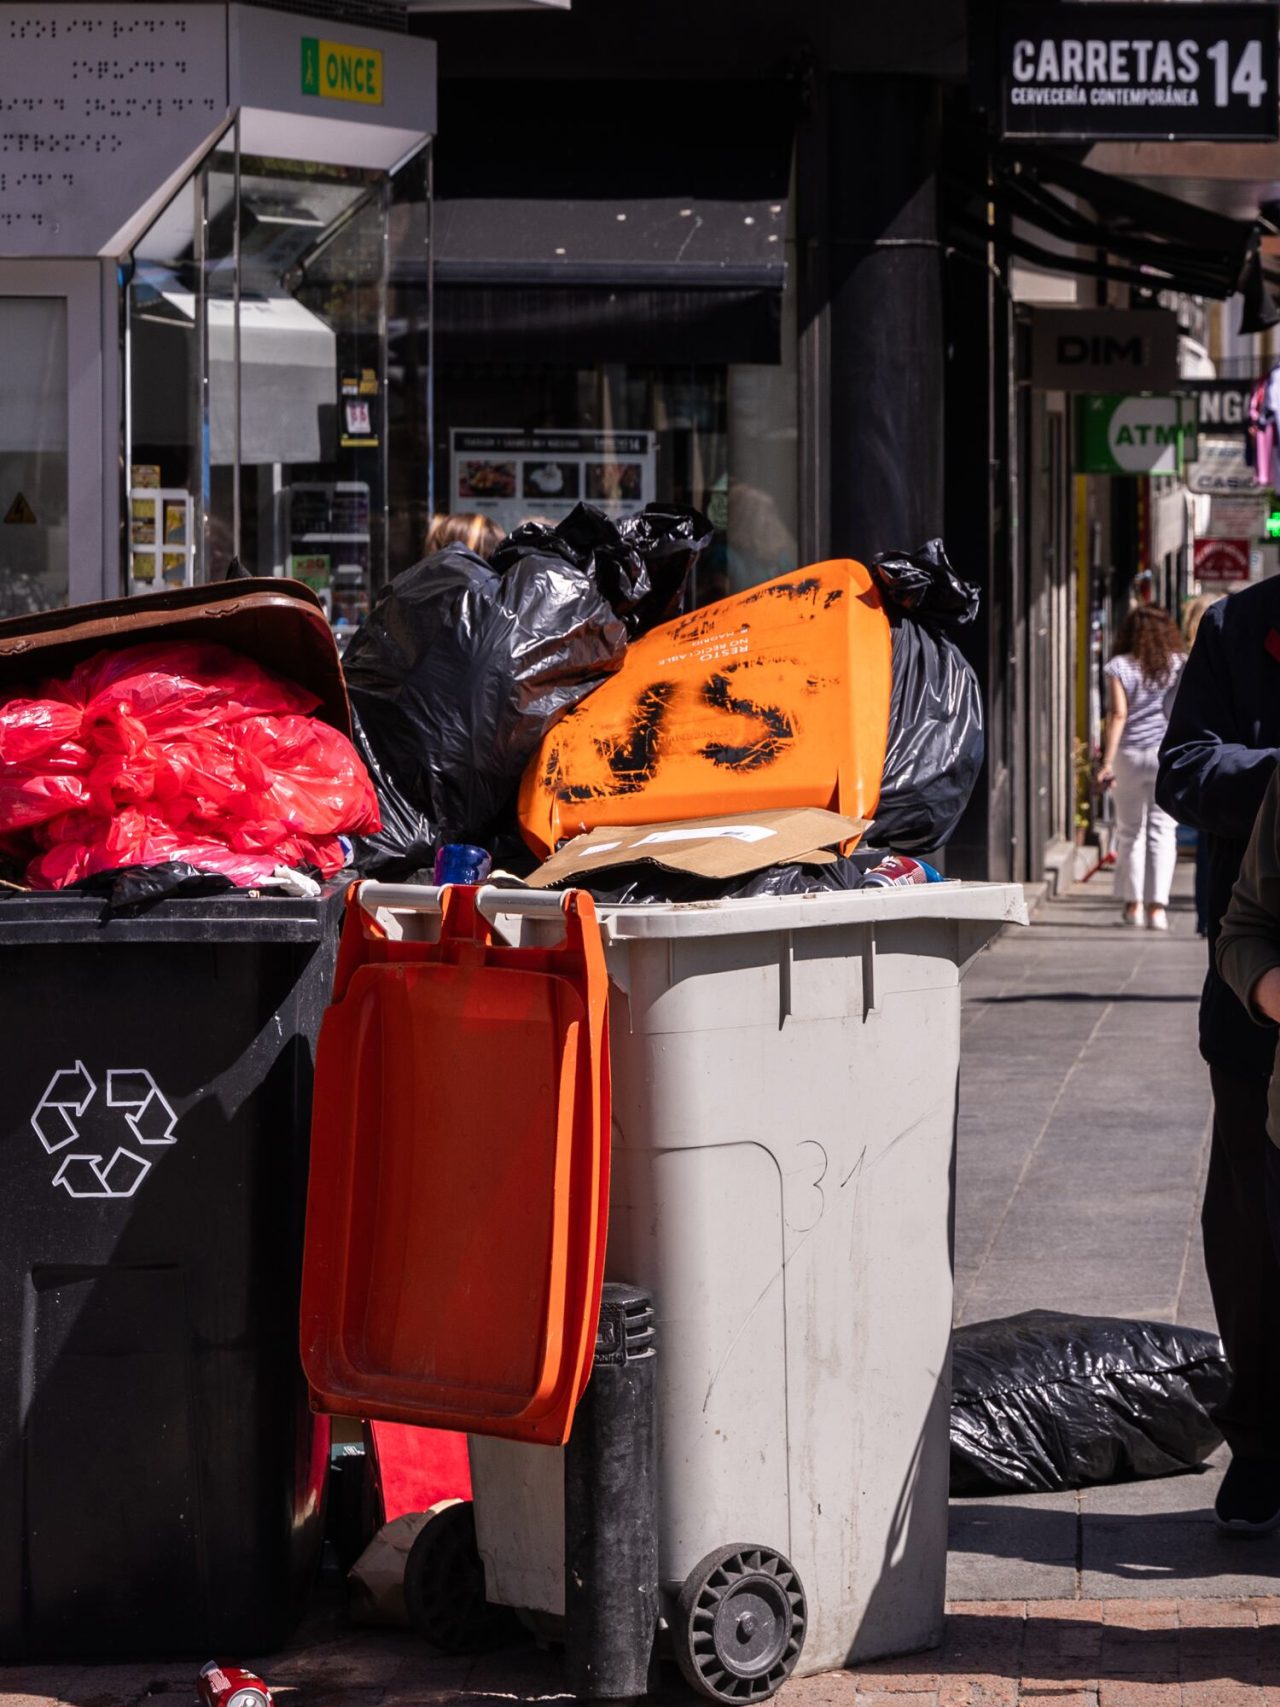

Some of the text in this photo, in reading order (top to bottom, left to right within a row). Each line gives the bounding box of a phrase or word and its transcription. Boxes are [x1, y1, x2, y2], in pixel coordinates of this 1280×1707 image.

[326, 52, 377, 95] ONCE
[1012, 39, 1268, 108] CARRETAS 14
[1011, 84, 1200, 107] CERVECERÍA CONTEMPORÁNEA
[1057, 334, 1142, 366] DIM
[1115, 424, 1178, 446] ATM
[699, 644, 749, 662] RESTO
